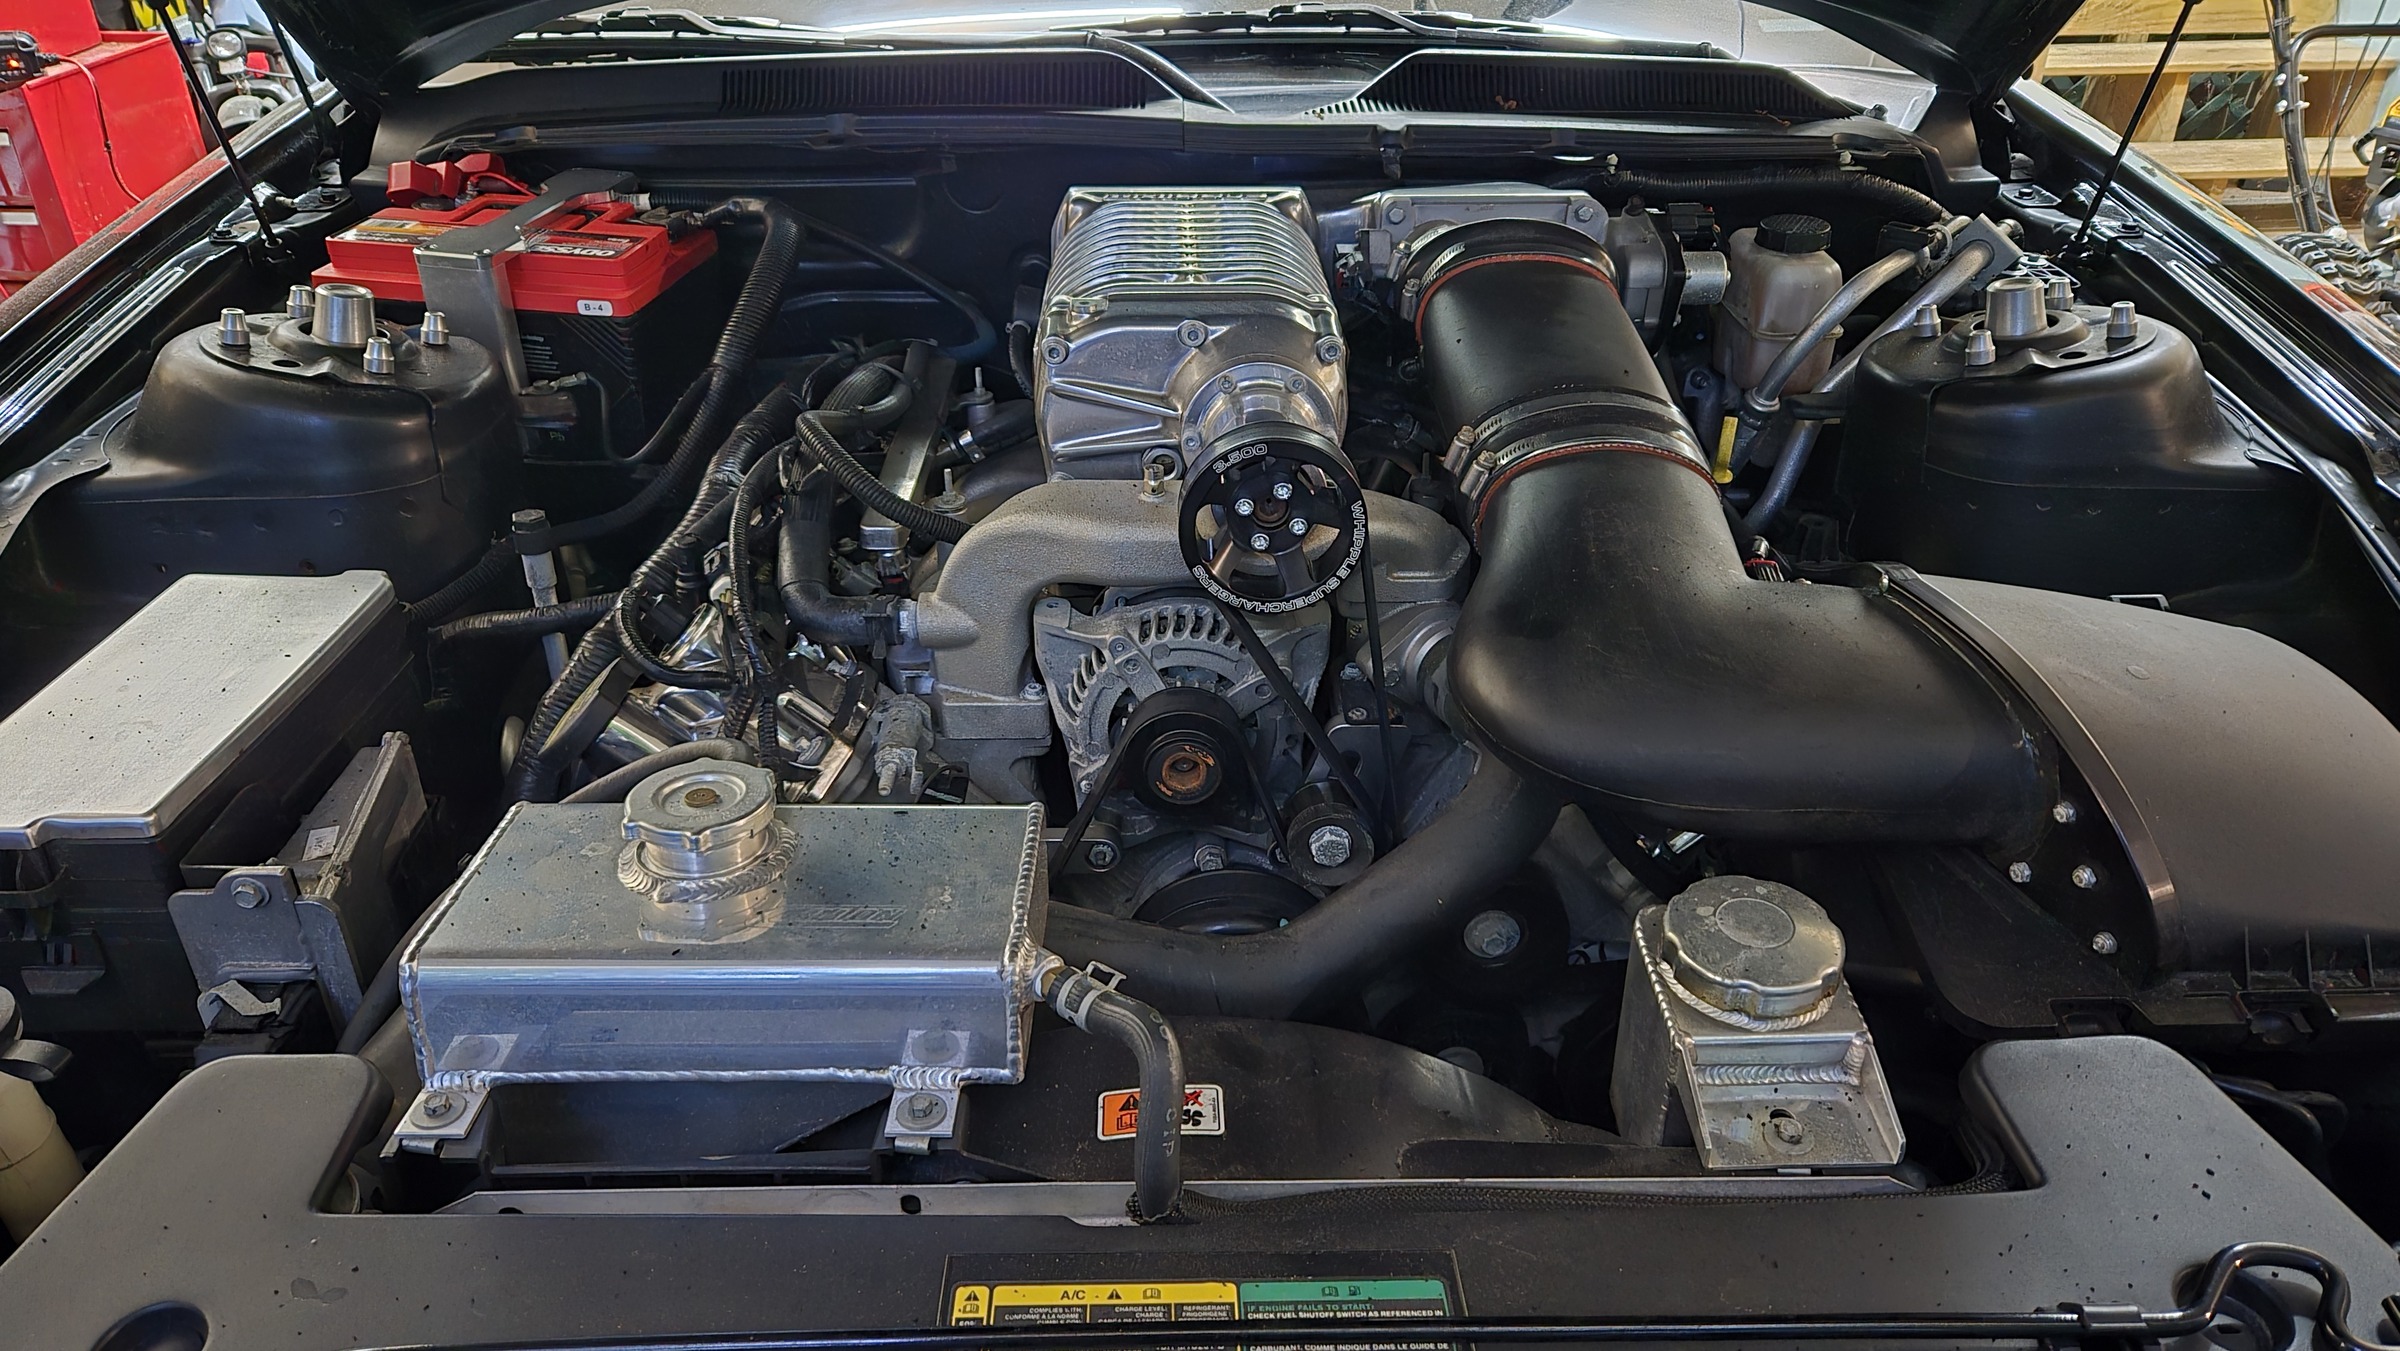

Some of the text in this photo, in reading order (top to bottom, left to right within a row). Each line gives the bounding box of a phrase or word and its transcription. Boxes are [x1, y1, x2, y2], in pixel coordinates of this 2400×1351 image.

[1212, 443, 1268, 474] 3.500
[1192, 500, 1366, 613] WHIPPLE SUPERCHARGERS
[1060, 1290, 1086, 1301] A/C
[1247, 1304, 1257, 1312] IF
[1259, 1304, 1295, 1312] ENGINE
[1325, 1303, 1340, 1311] TO
[1247, 1312, 1276, 1320] CHECK
[1298, 1311, 1335, 1319] SHUTOFF
[1336, 1310, 1366, 1318] SWITCH
[1368, 1310, 1379, 1318] AS
[1380, 1309, 1433, 1317] REFERENCED
[1372, 1343, 1396, 1351] DANS
[1409, 1342, 1434, 1350] GUIDE
[1436, 1342, 1449, 1350] DE
